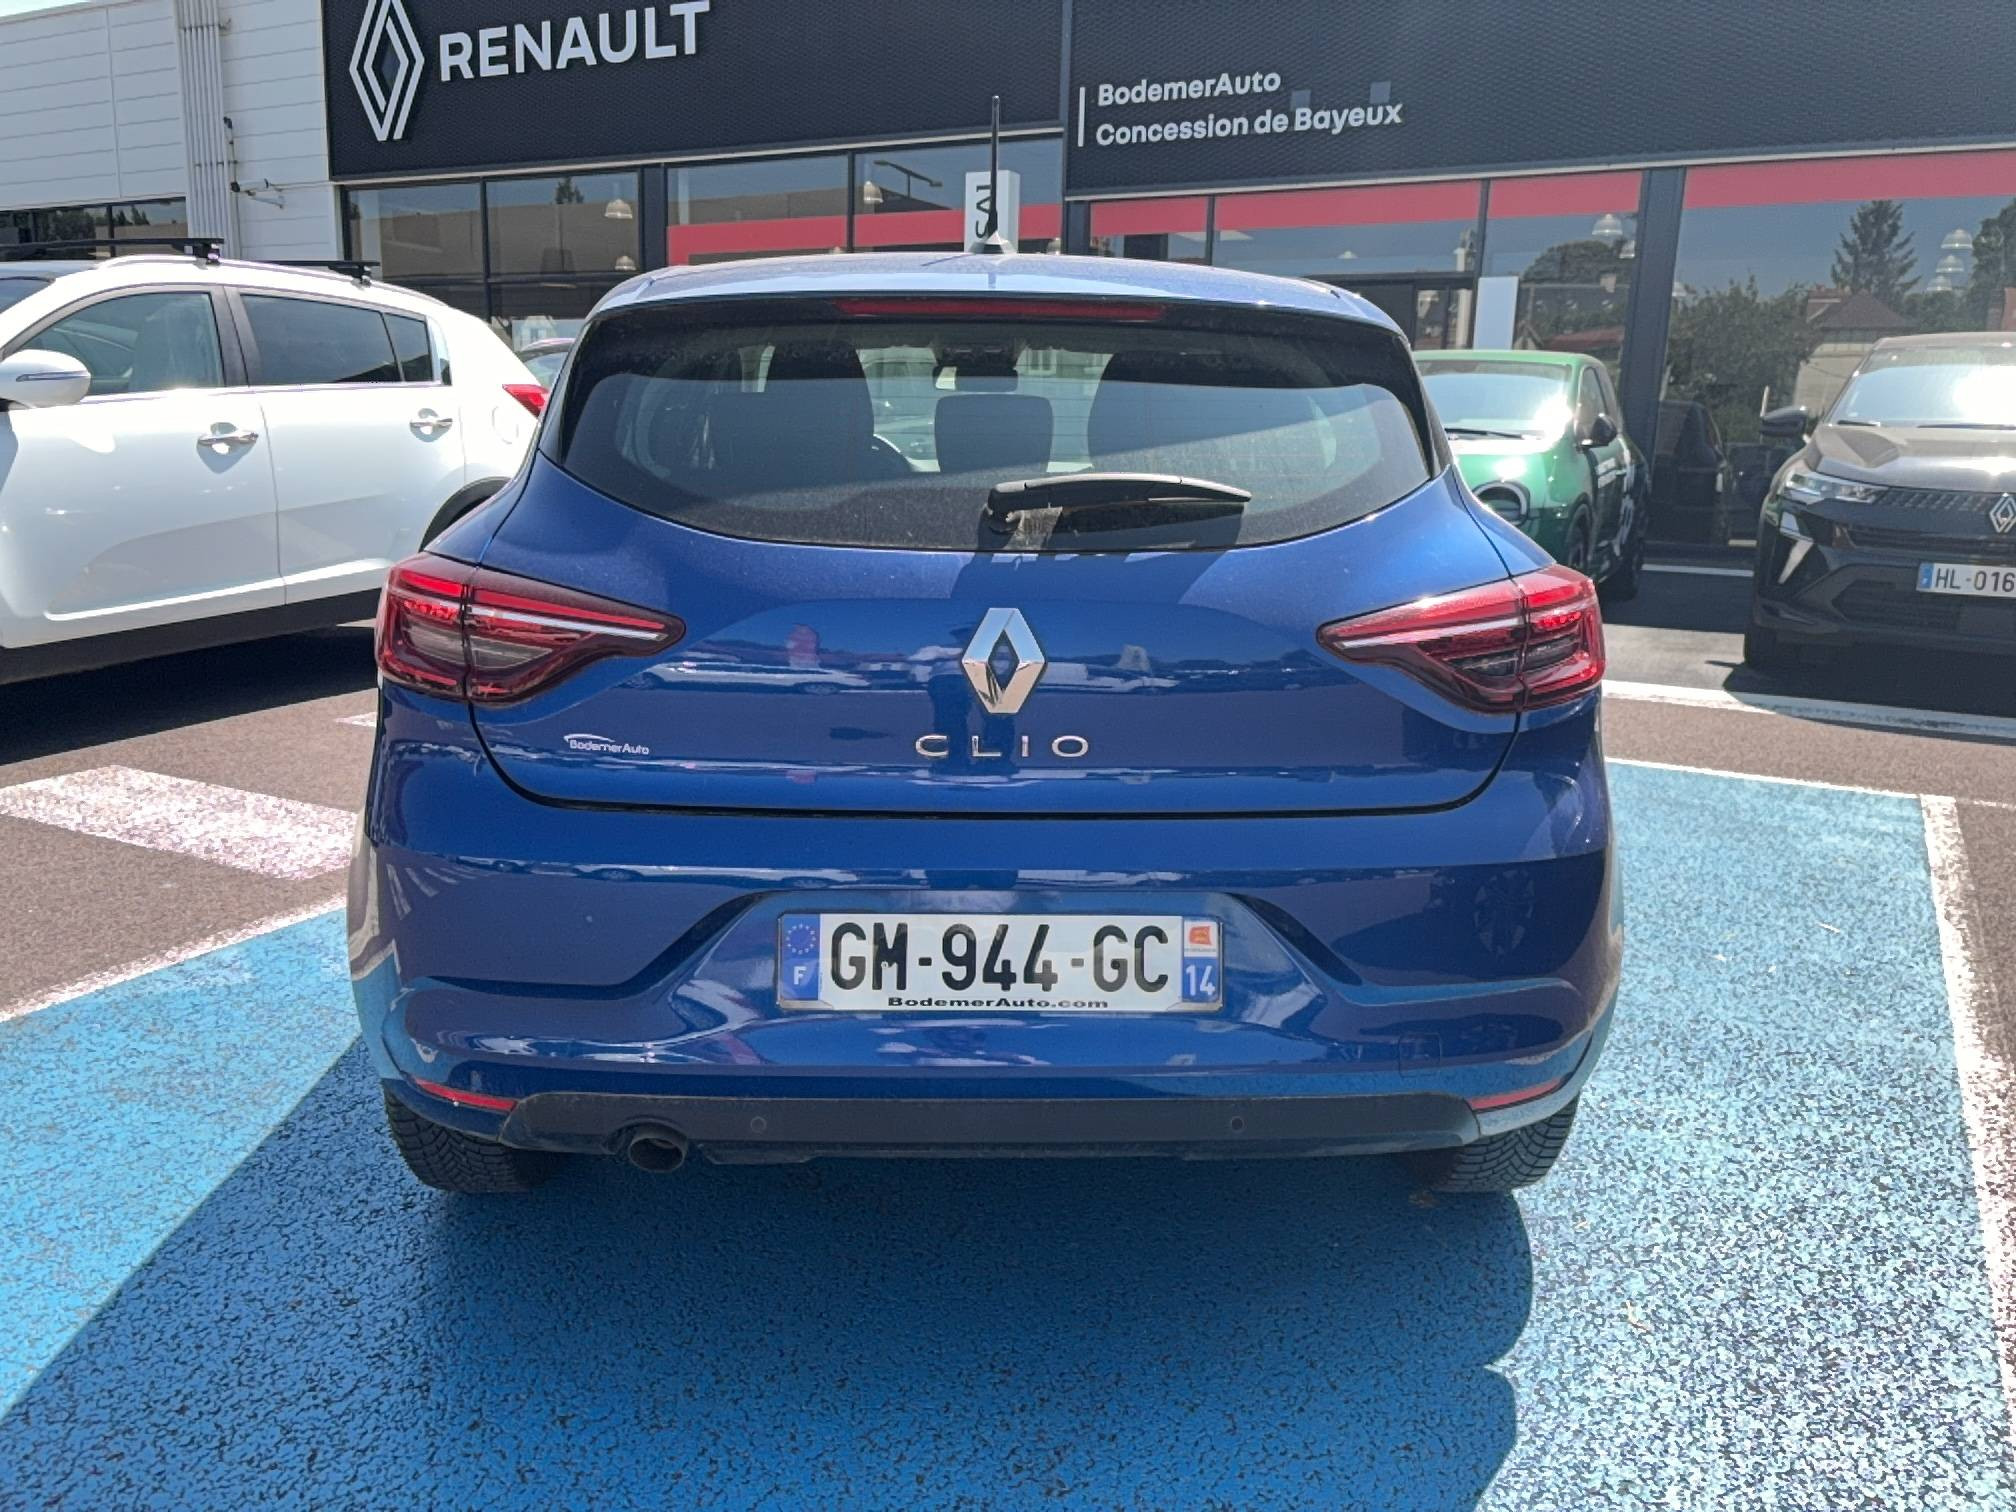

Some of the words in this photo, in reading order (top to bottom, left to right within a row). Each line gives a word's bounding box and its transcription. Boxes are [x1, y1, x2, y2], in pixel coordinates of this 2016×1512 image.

[439, 0, 710, 82] RENAULT
[1098, 72, 1281, 106] BodemerAuto
[1096, 114, 1248, 146] Concession
[1253, 110, 1289, 135] de
[1294, 103, 1403, 135] Bayeux
[569, 739, 650, 755] BodemerAuto
[914, 735, 1089, 757] CLIO
[830, 921, 1169, 993] GM-944-GC
[793, 966, 808, 985] F
[1185, 964, 1216, 996] 14
[888, 996, 1109, 1009] BodemerAuto.com
